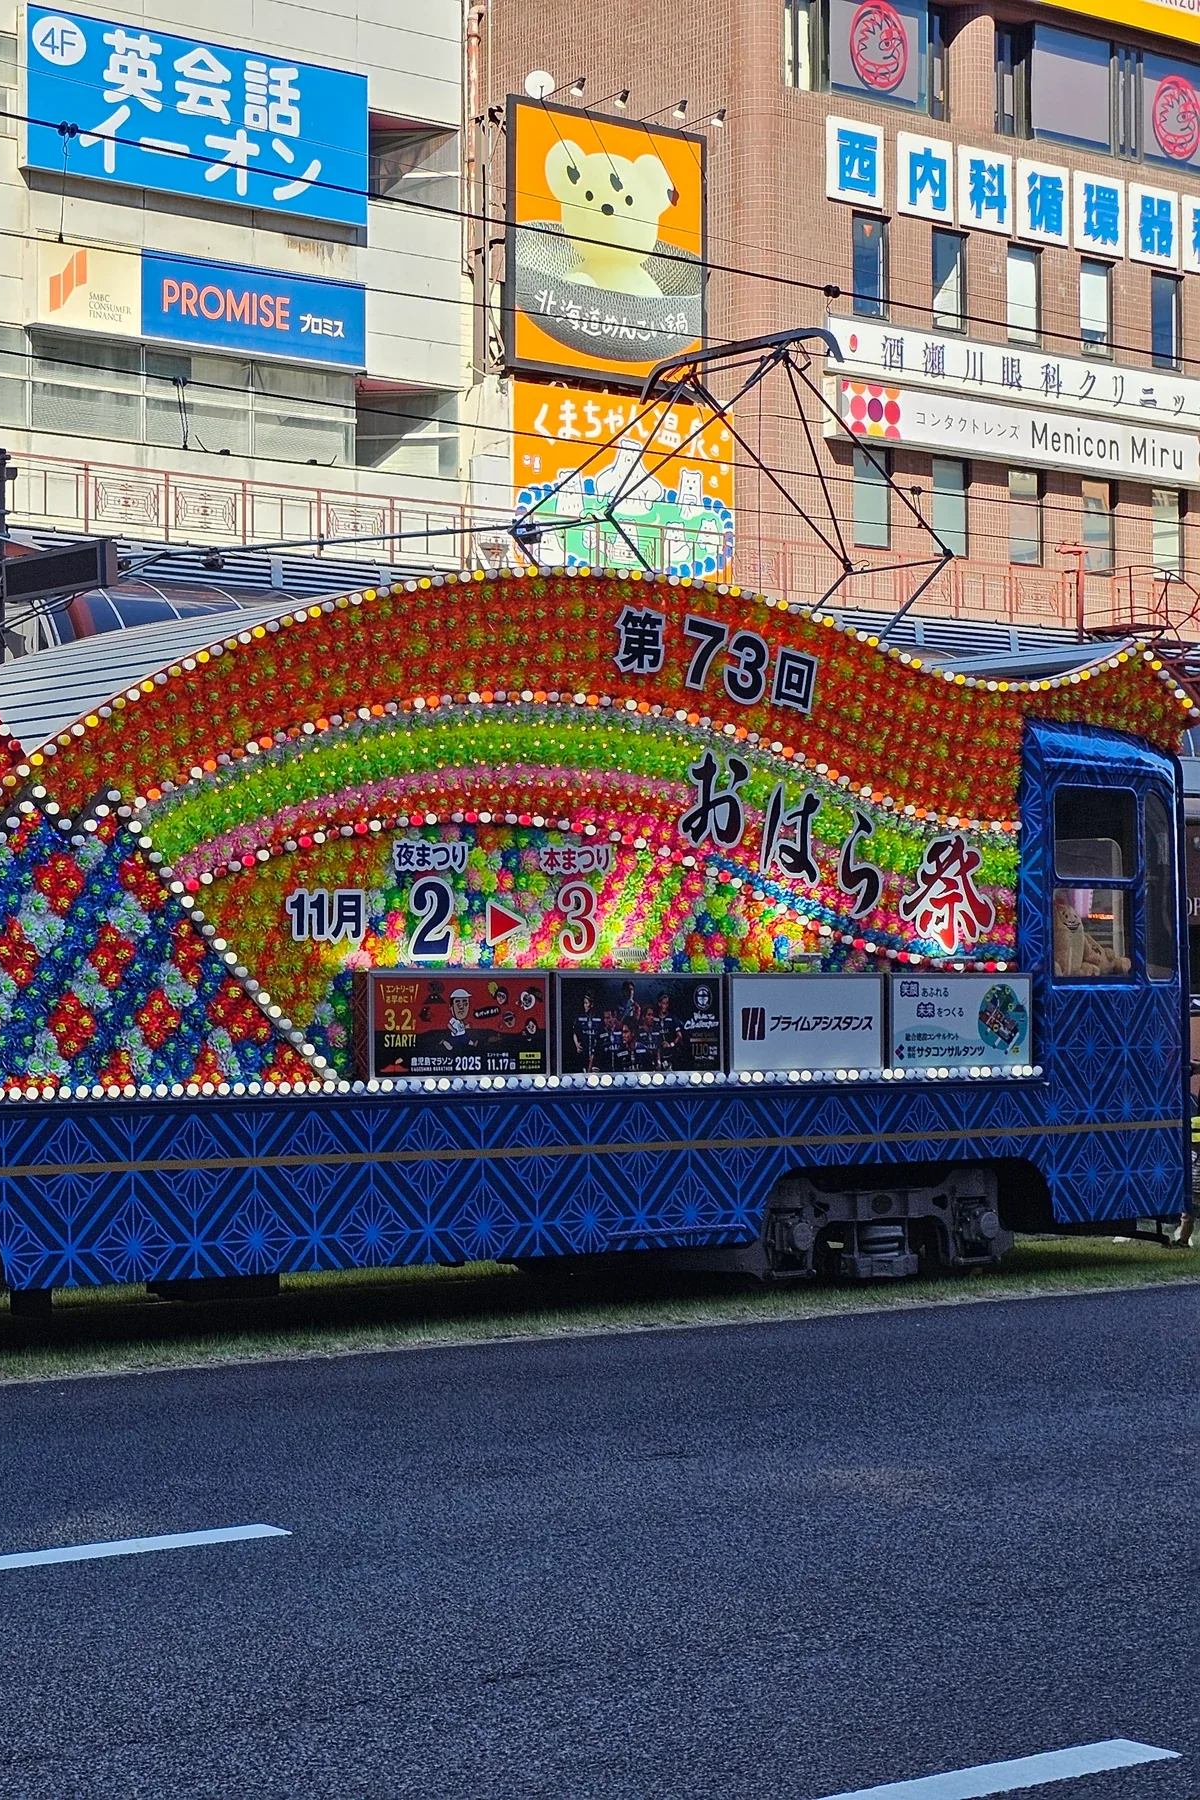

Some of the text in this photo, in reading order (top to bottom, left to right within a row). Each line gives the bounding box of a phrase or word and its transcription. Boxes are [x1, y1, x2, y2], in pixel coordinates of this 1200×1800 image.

[40, 27, 77, 58] 4F
[102, 29, 301, 138] 英会話
[79, 104, 322, 201] イーオン
[89, 291, 111, 303] SMBC
[89, 301, 132, 315] CONSUMER
[162, 279, 291, 331] PROMISE
[89, 311, 123, 323] FINANCE
[299, 313, 346, 339] プロミス
[534, 289, 689, 341] 北海道めんこい鍋
[534, 399, 712, 460] くまちゃん温泉
[915, 409, 1184, 471] コンタクトレンズ Menicon Miru
[614, 605, 818, 714] 第73回
[395, 842, 467, 869] 夜まつり
[542, 848, 611, 871] 本まつり
[678, 749, 996, 955] おはら祭
[289, 881, 595, 956] 11月 2 3
[921, 987, 949, 998] あふれる
[384, 1008, 412, 1031] 3.2
[770, 1015, 873, 1031] プライムアシスタンス
[937, 1007, 964, 1017] をつくる
[384, 1034, 416, 1048] START!
[916, 1045, 985, 1057] サタコンサルタンツ
[455, 1056, 482, 1071] 2025
[487, 1058, 509, 1071] 11.17
